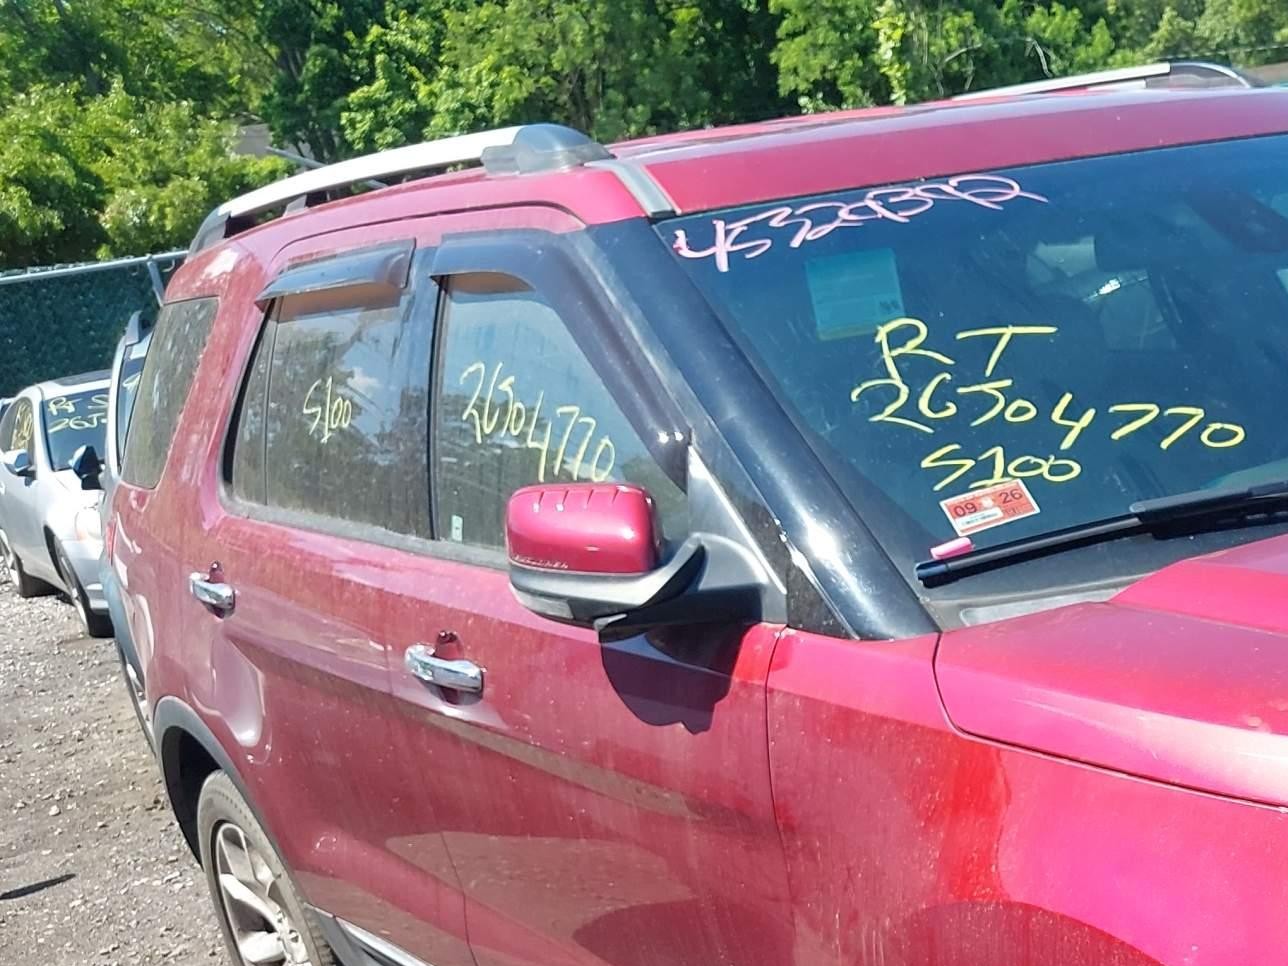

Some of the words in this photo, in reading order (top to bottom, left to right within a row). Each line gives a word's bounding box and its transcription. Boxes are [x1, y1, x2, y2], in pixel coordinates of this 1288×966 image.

[920, 443, 1082, 492] S100
[953, 502, 978, 518] 09
[999, 488, 1023, 505] 26
